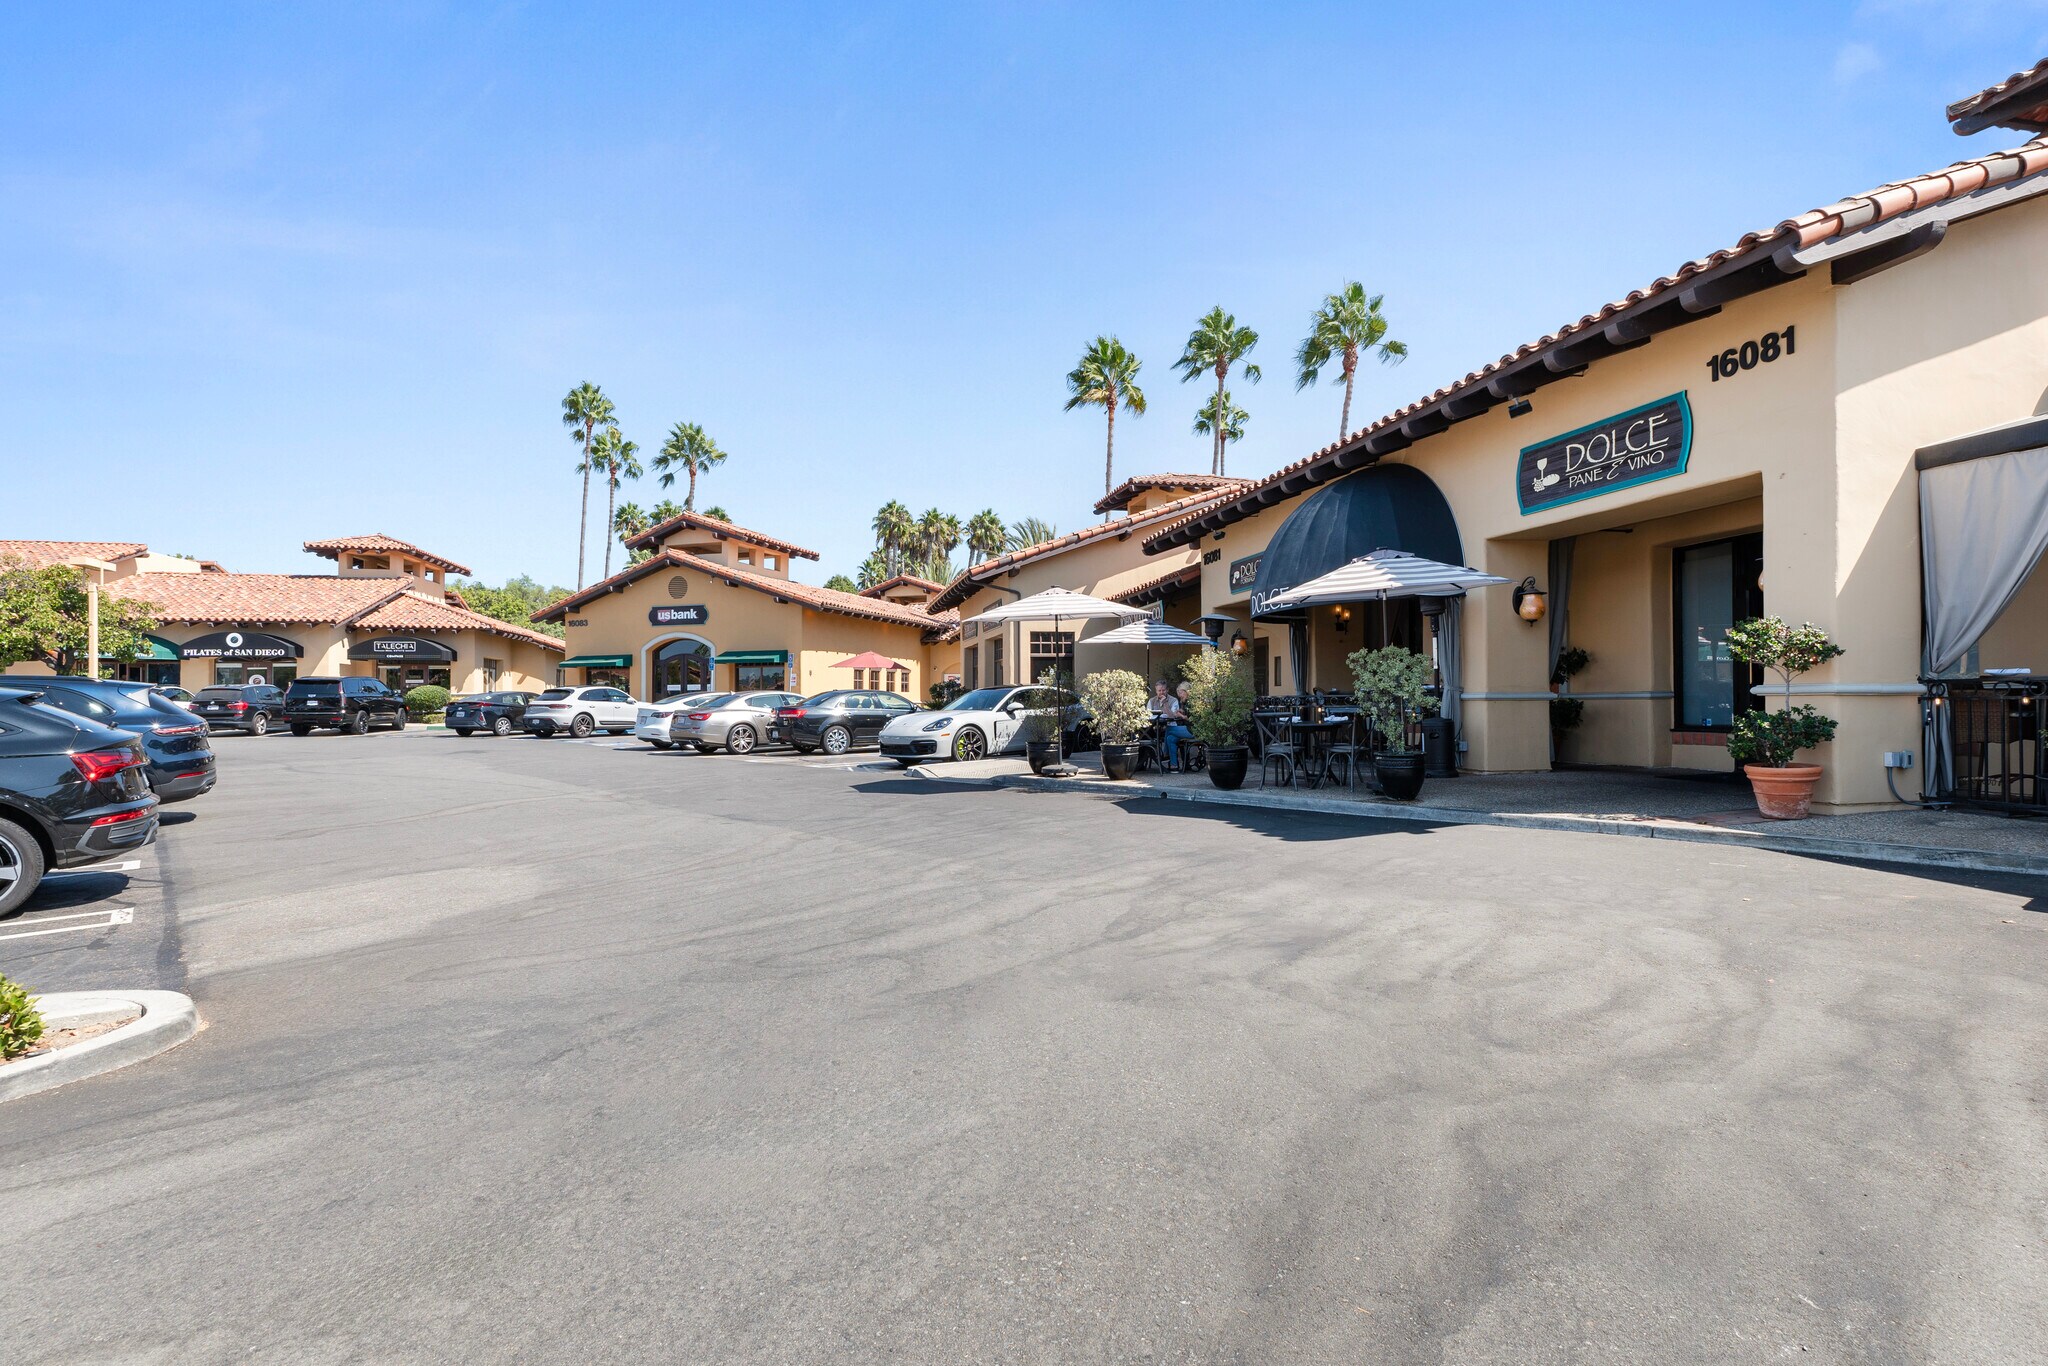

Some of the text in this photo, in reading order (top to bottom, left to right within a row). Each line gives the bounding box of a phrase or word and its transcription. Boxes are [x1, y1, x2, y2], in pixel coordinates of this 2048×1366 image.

[1706, 325, 1795, 382] 16081
[1565, 412, 1669, 472] DOLCE
[1568, 468, 1604, 488] PANE
[1627, 449, 1665, 471] VINO
[1240, 559, 1262, 577] DOLC
[567, 619, 589, 628] 16083
[183, 648, 285, 656] PILATES of SAN DIEGO
